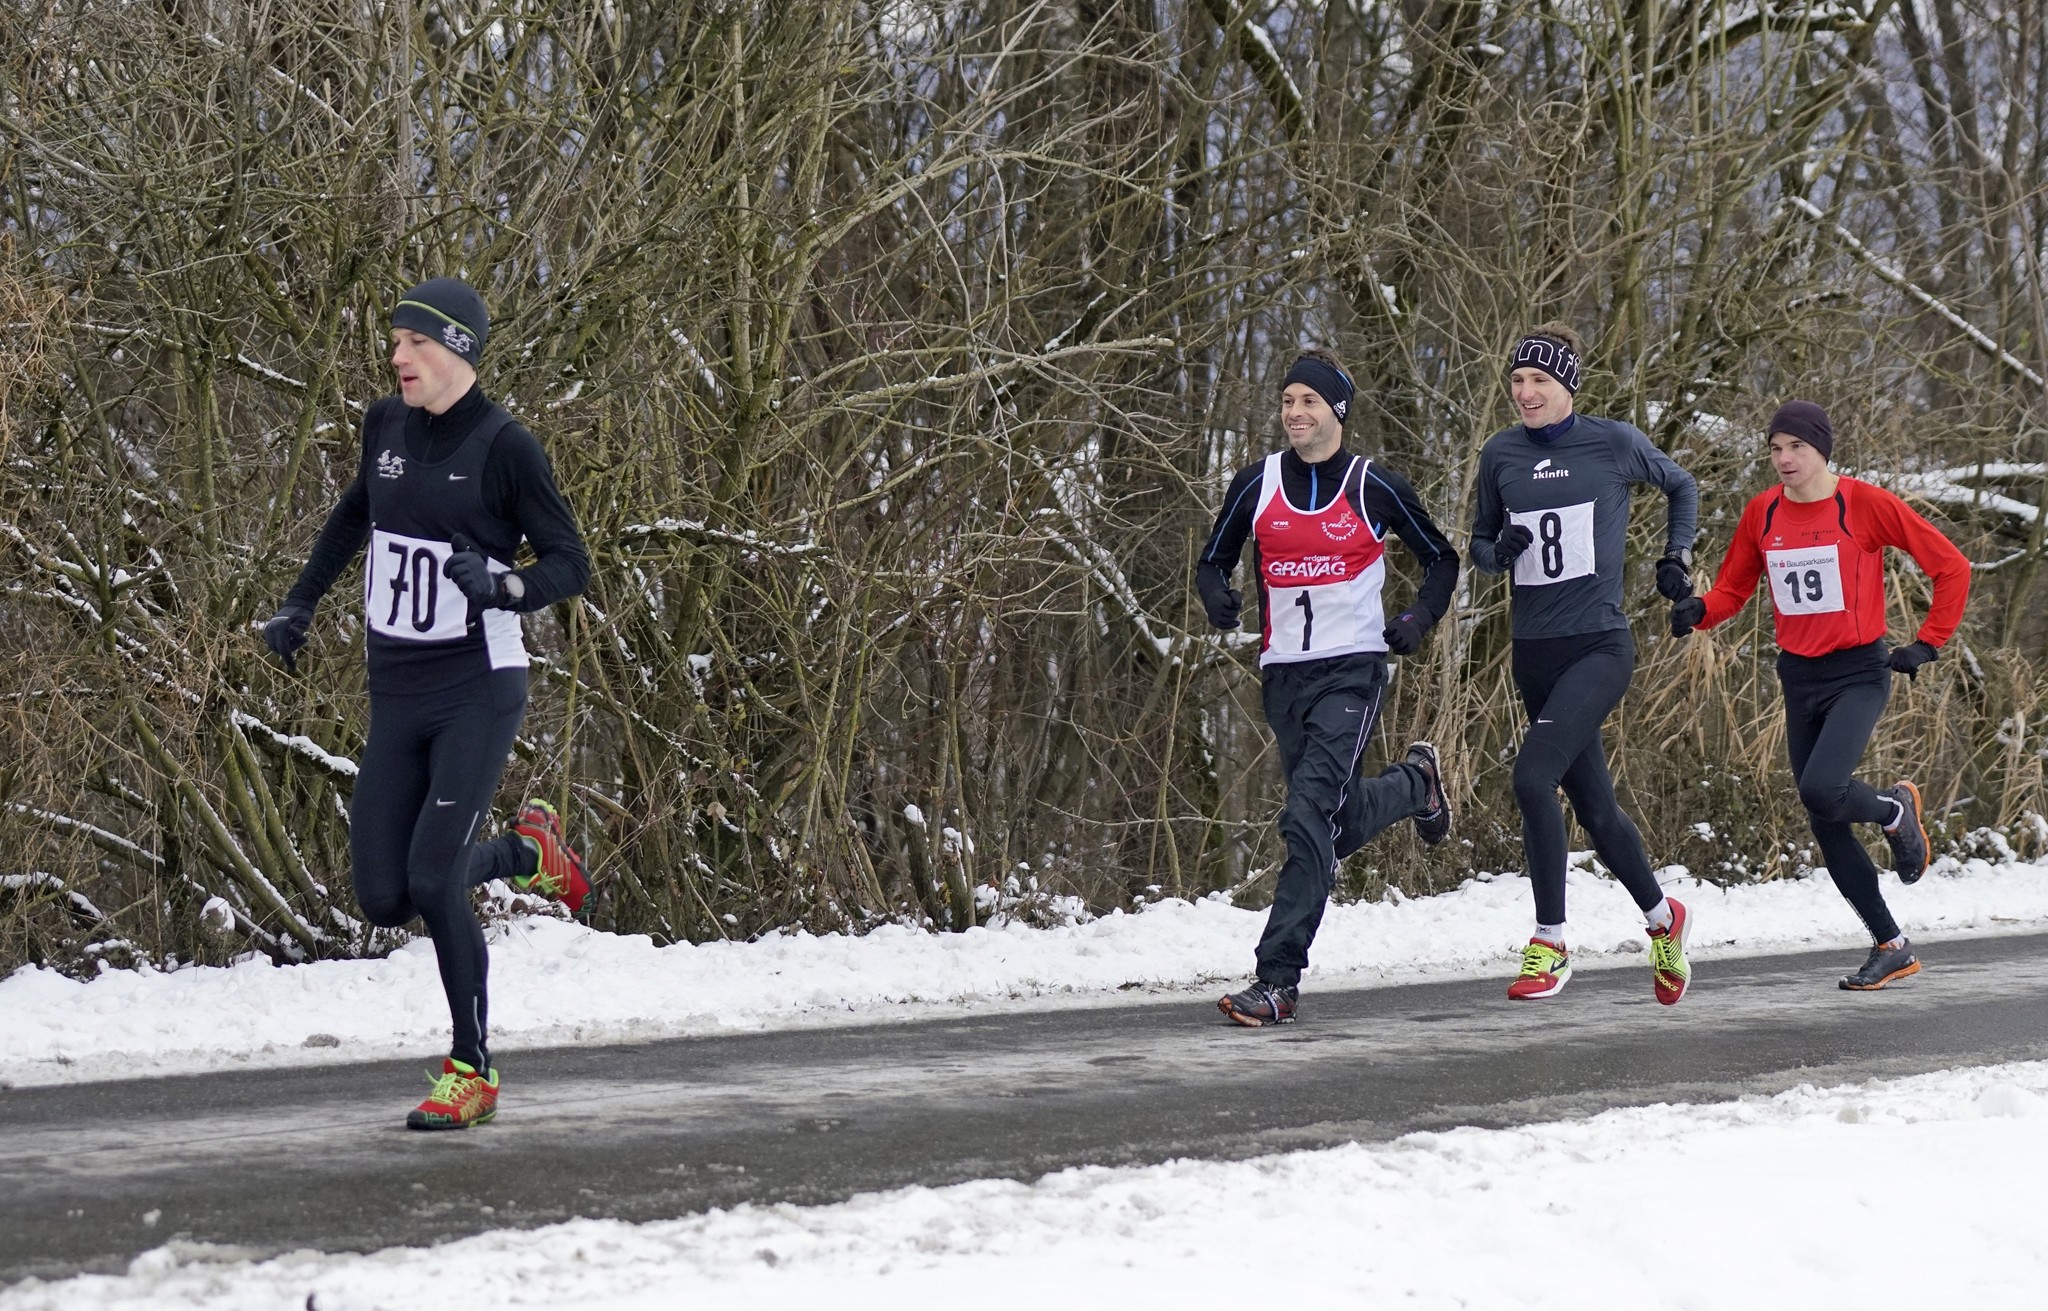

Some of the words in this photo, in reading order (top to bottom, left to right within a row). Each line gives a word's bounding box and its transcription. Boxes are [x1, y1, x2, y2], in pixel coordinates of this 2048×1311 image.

[1533, 469, 1569, 480] skinfit
[1539, 511, 1564, 579] 8
[1268, 561, 1346, 577] GRAVAG
[1303, 555, 1330, 563] erdgas
[1769, 560, 1778, 568] Die
[1786, 556, 1834, 567] Bausparkasse
[386, 541, 439, 633] 70
[1783, 569, 1824, 604] 19
[1295, 590, 1314, 651] 1
